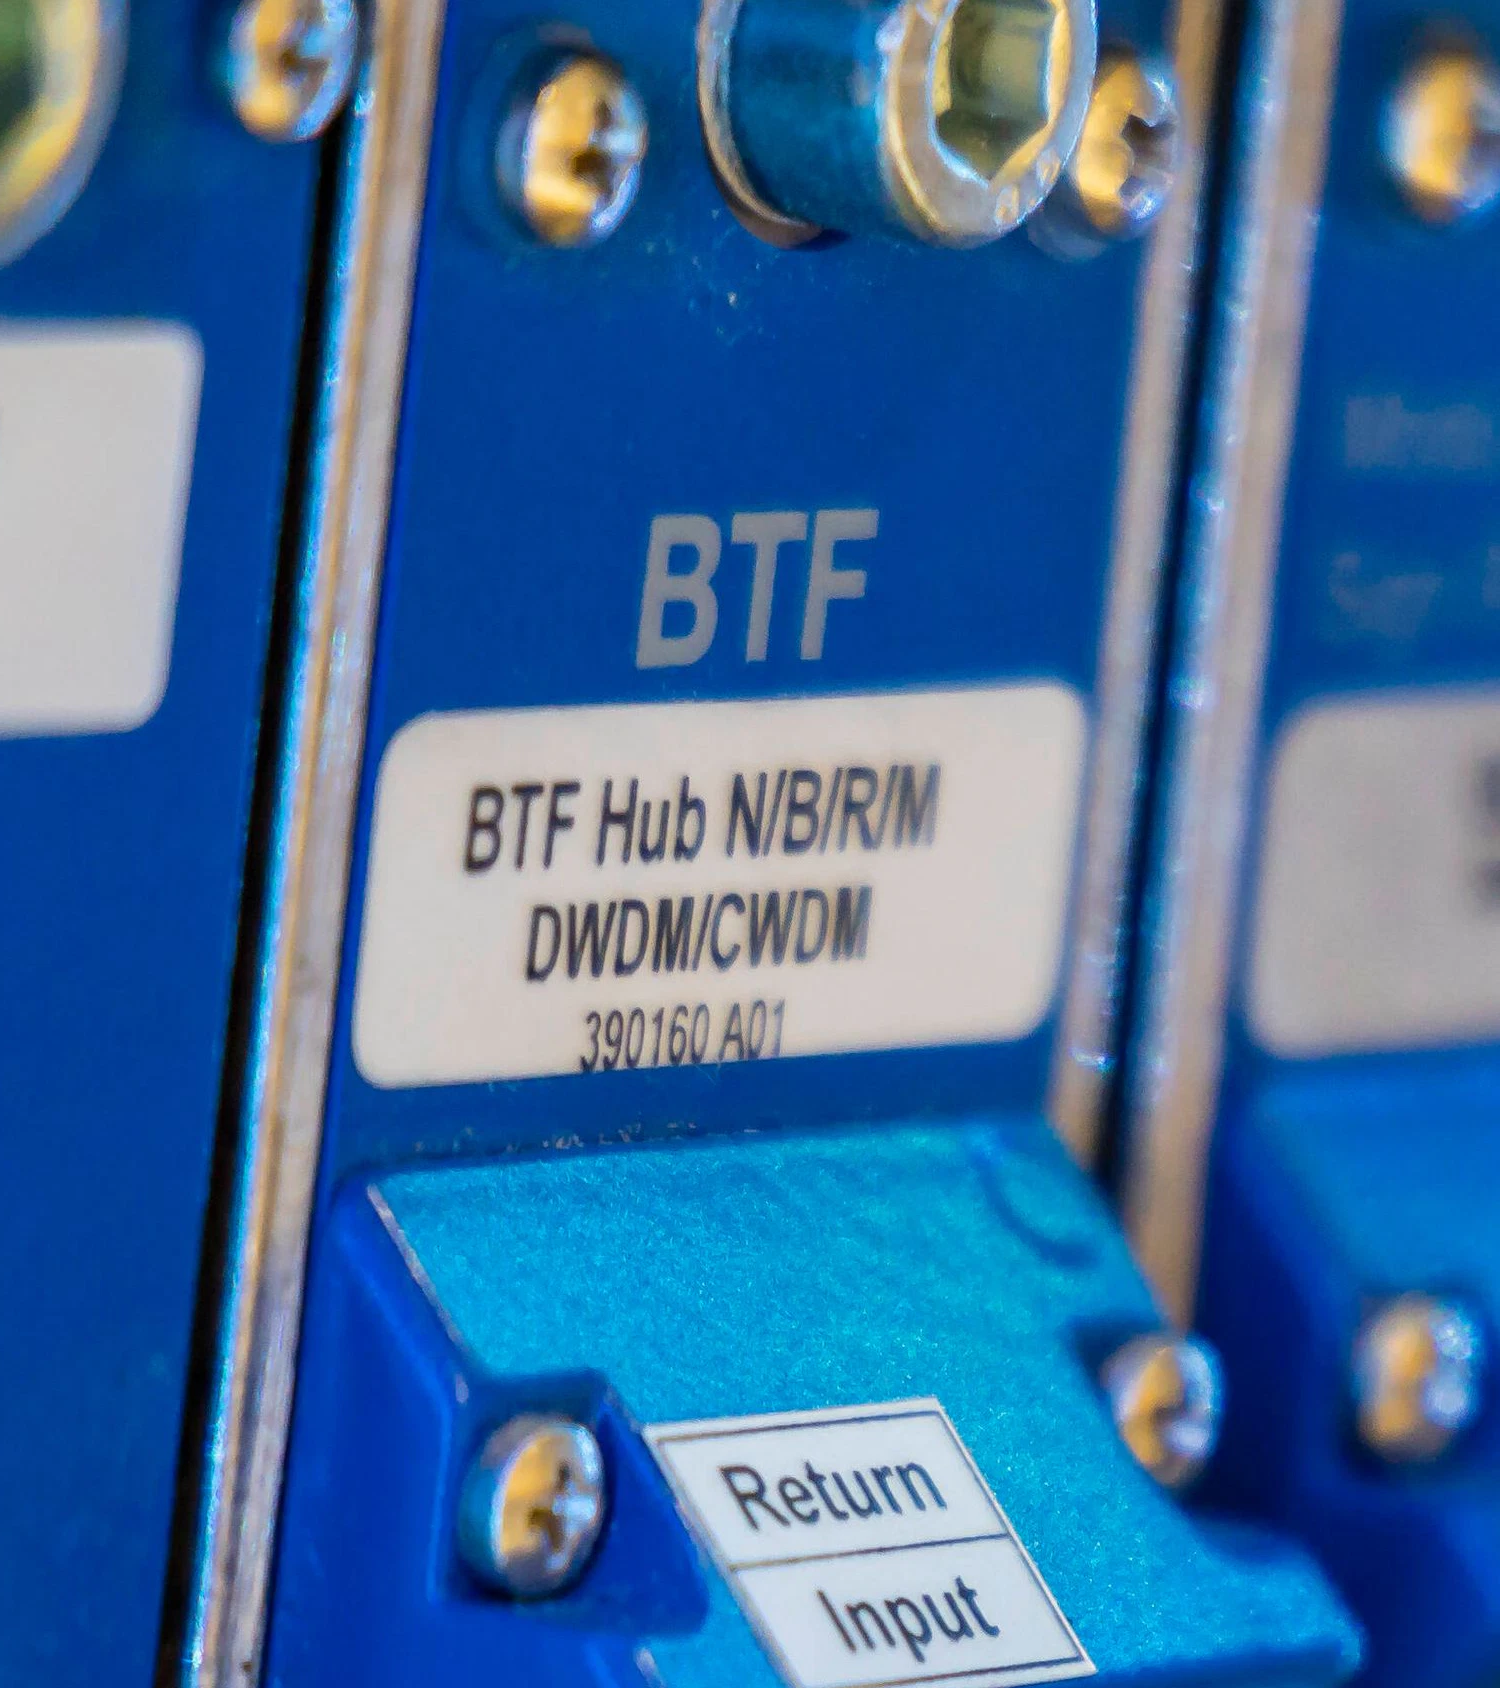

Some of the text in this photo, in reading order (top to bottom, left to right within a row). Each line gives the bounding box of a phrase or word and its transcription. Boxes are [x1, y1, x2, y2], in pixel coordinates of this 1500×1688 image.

[635, 508, 880, 670] BTF
[463, 763, 942, 876] BTF Hub N/B/R/M
[524, 886, 874, 983] DWDM/CWDM
[578, 999, 786, 1074] 390160 A01
[718, 1459, 948, 1532] Return
[815, 1575, 1000, 1663] Input
